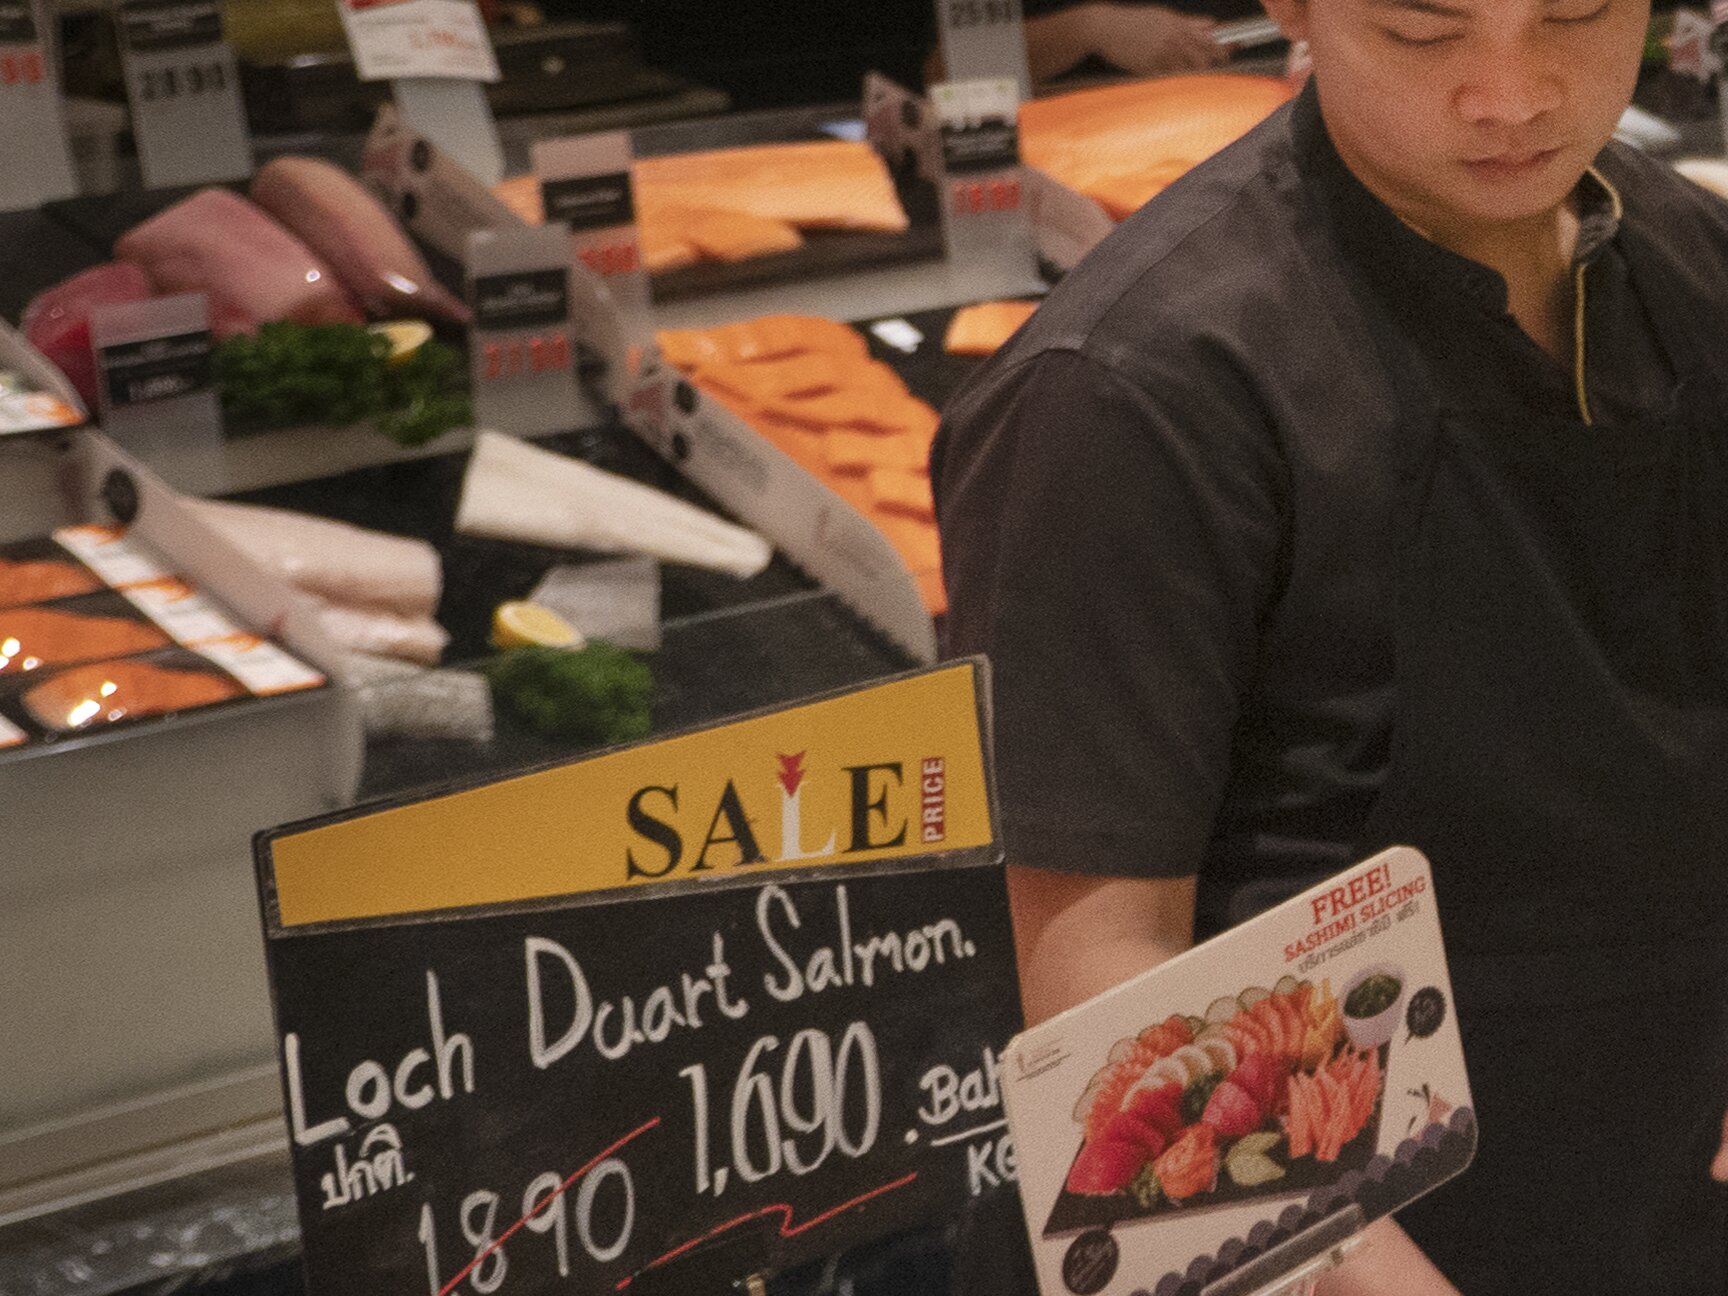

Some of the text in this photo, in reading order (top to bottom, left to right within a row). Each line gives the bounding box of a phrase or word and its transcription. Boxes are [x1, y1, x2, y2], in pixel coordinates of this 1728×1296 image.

[626, 759, 909, 882] SALE
[922, 757, 945, 844] PRICE
[1284, 875, 1426, 963] SASHIMI SLICING
[1311, 862, 1392, 926] FREE!
[284, 968, 476, 1147] Loch
[525, 930, 750, 1071] Duart
